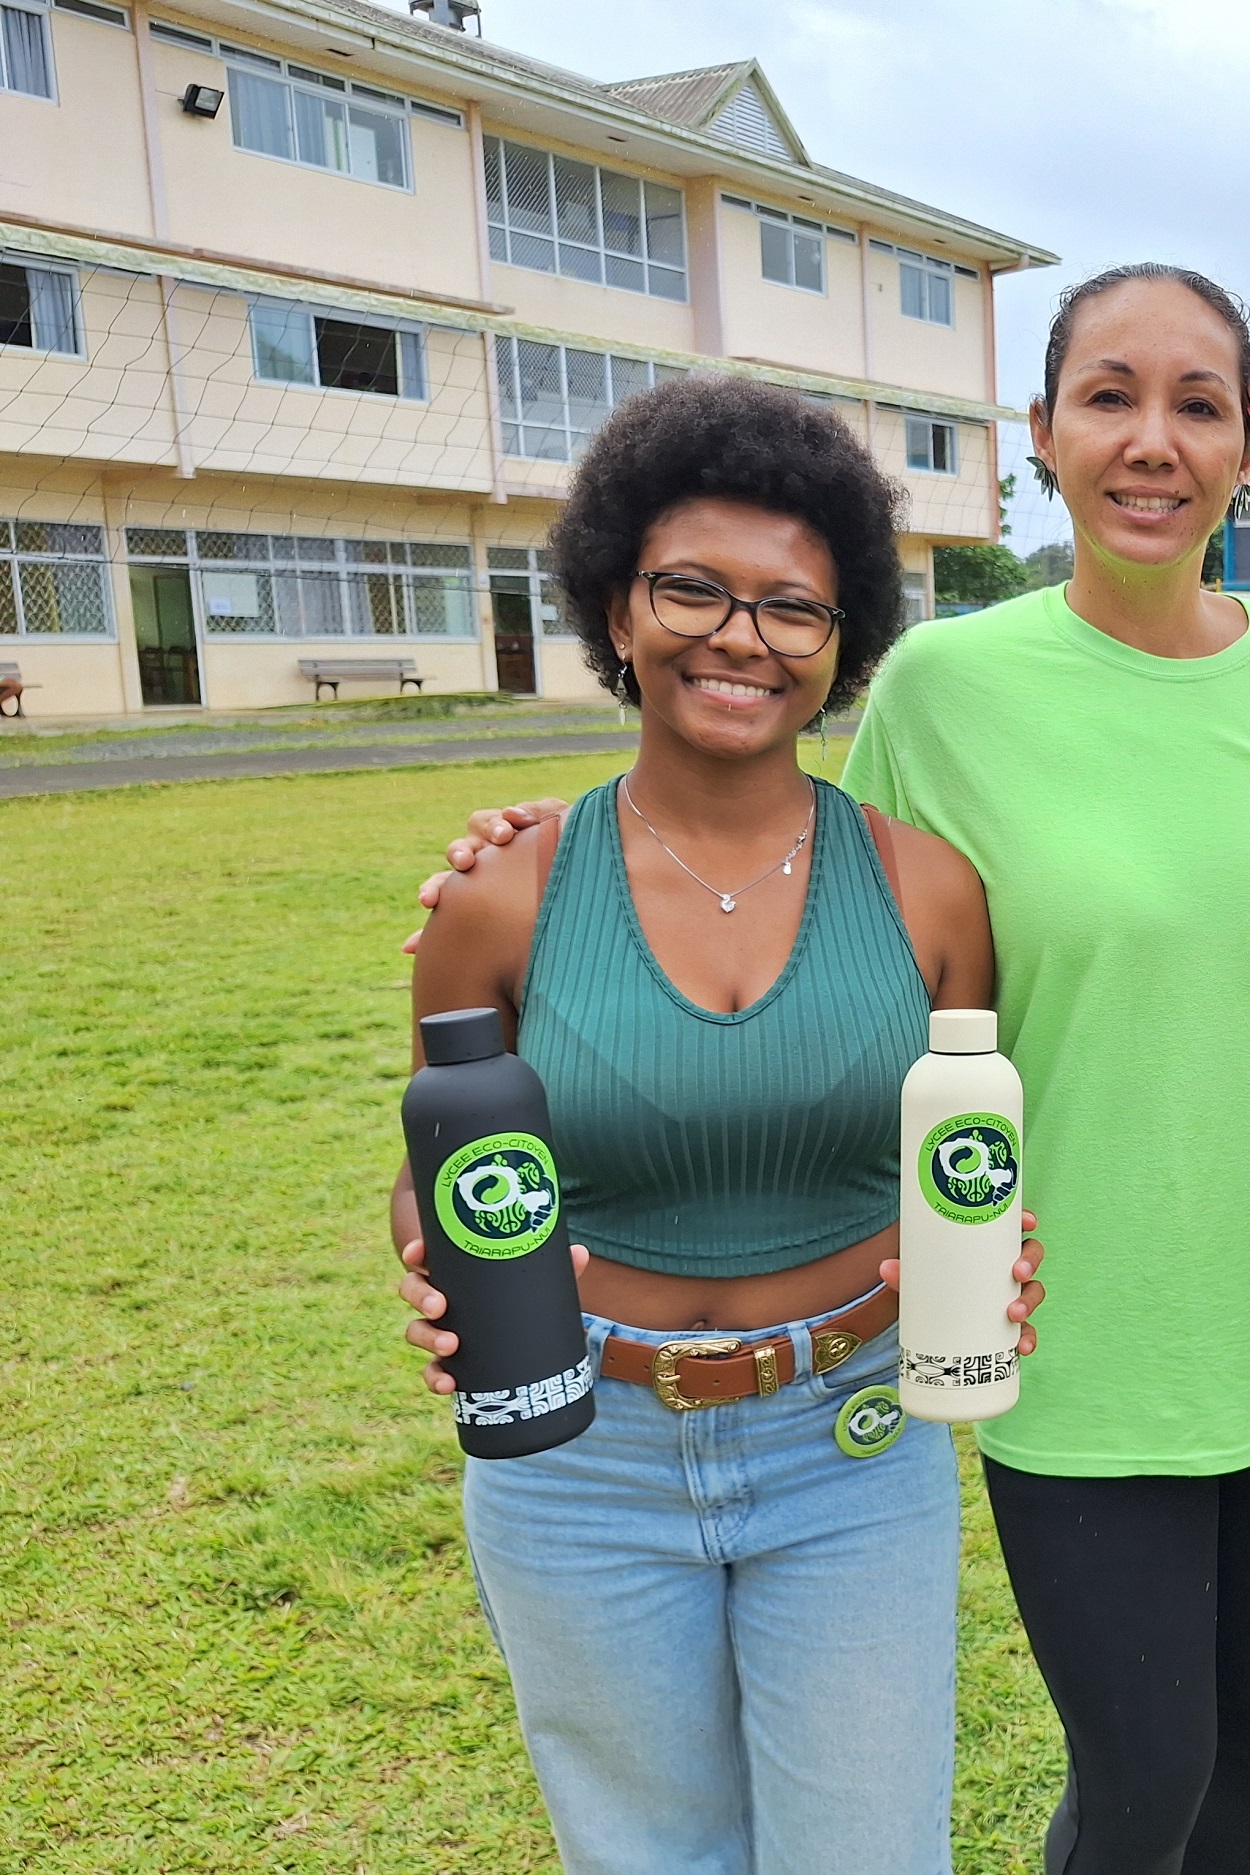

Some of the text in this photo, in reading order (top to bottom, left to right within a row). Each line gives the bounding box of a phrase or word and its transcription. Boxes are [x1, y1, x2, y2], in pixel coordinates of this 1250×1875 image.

[925, 1117, 1017, 1152] LYCEE ECO-CITOYEN
[441, 1138, 549, 1188] LYCEE ECO-CITOYEN
[934, 1202, 1009, 1224] TAIARAPU-NUI
[463, 1227, 551, 1258] TAIARAPU-NUI
